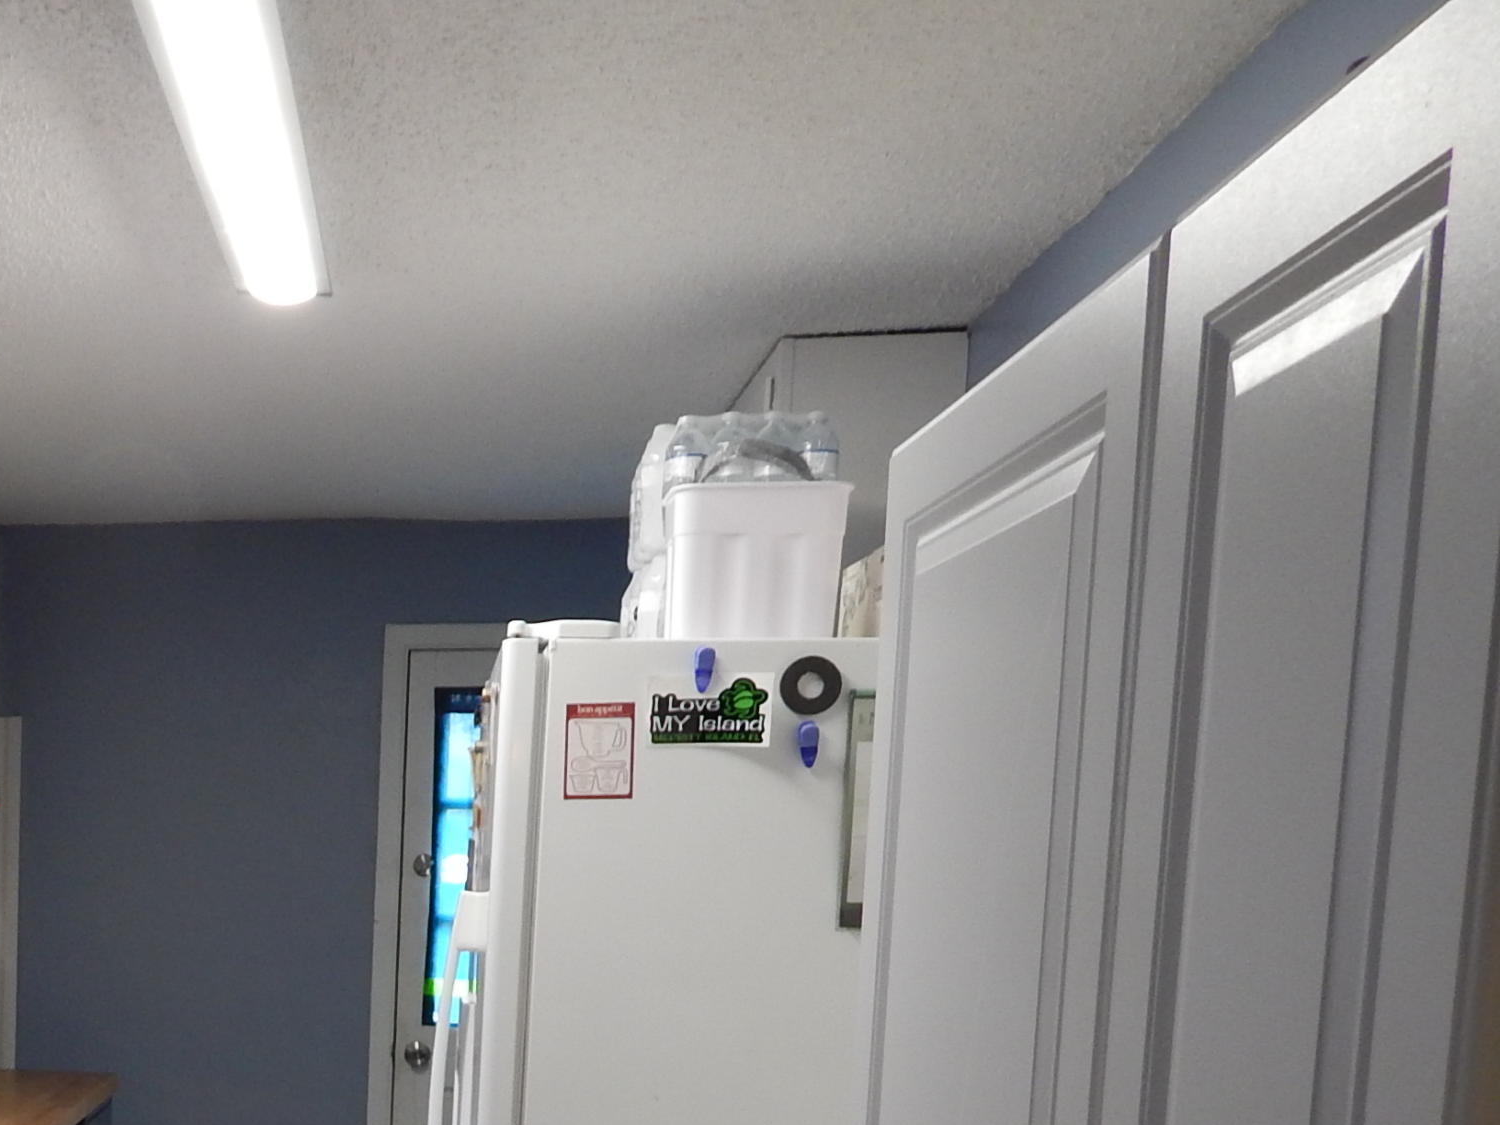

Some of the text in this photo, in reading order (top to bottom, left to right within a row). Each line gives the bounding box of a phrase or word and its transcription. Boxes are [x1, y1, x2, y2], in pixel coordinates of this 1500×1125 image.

[653, 695, 721, 713] I Love
[652, 714, 763, 732] MY Island
